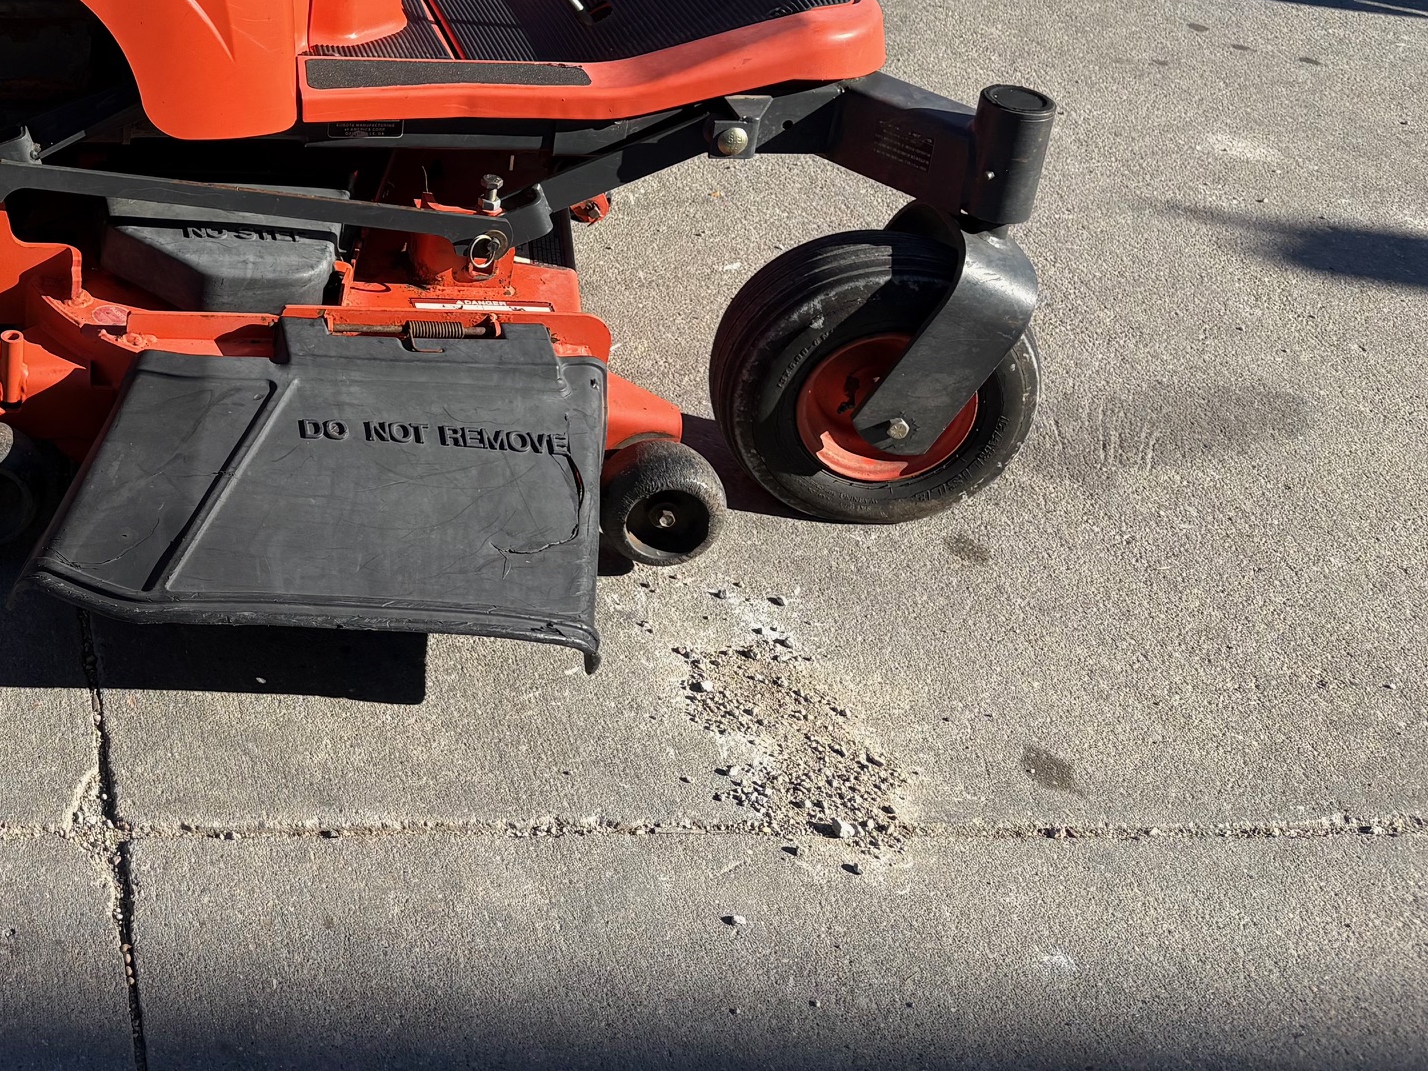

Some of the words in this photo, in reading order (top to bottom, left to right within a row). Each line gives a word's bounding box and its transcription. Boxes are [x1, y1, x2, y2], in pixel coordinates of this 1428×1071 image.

[297, 418, 349, 441] DO
[362, 420, 430, 445] NOT
[437, 424, 571, 456] REMOVE
